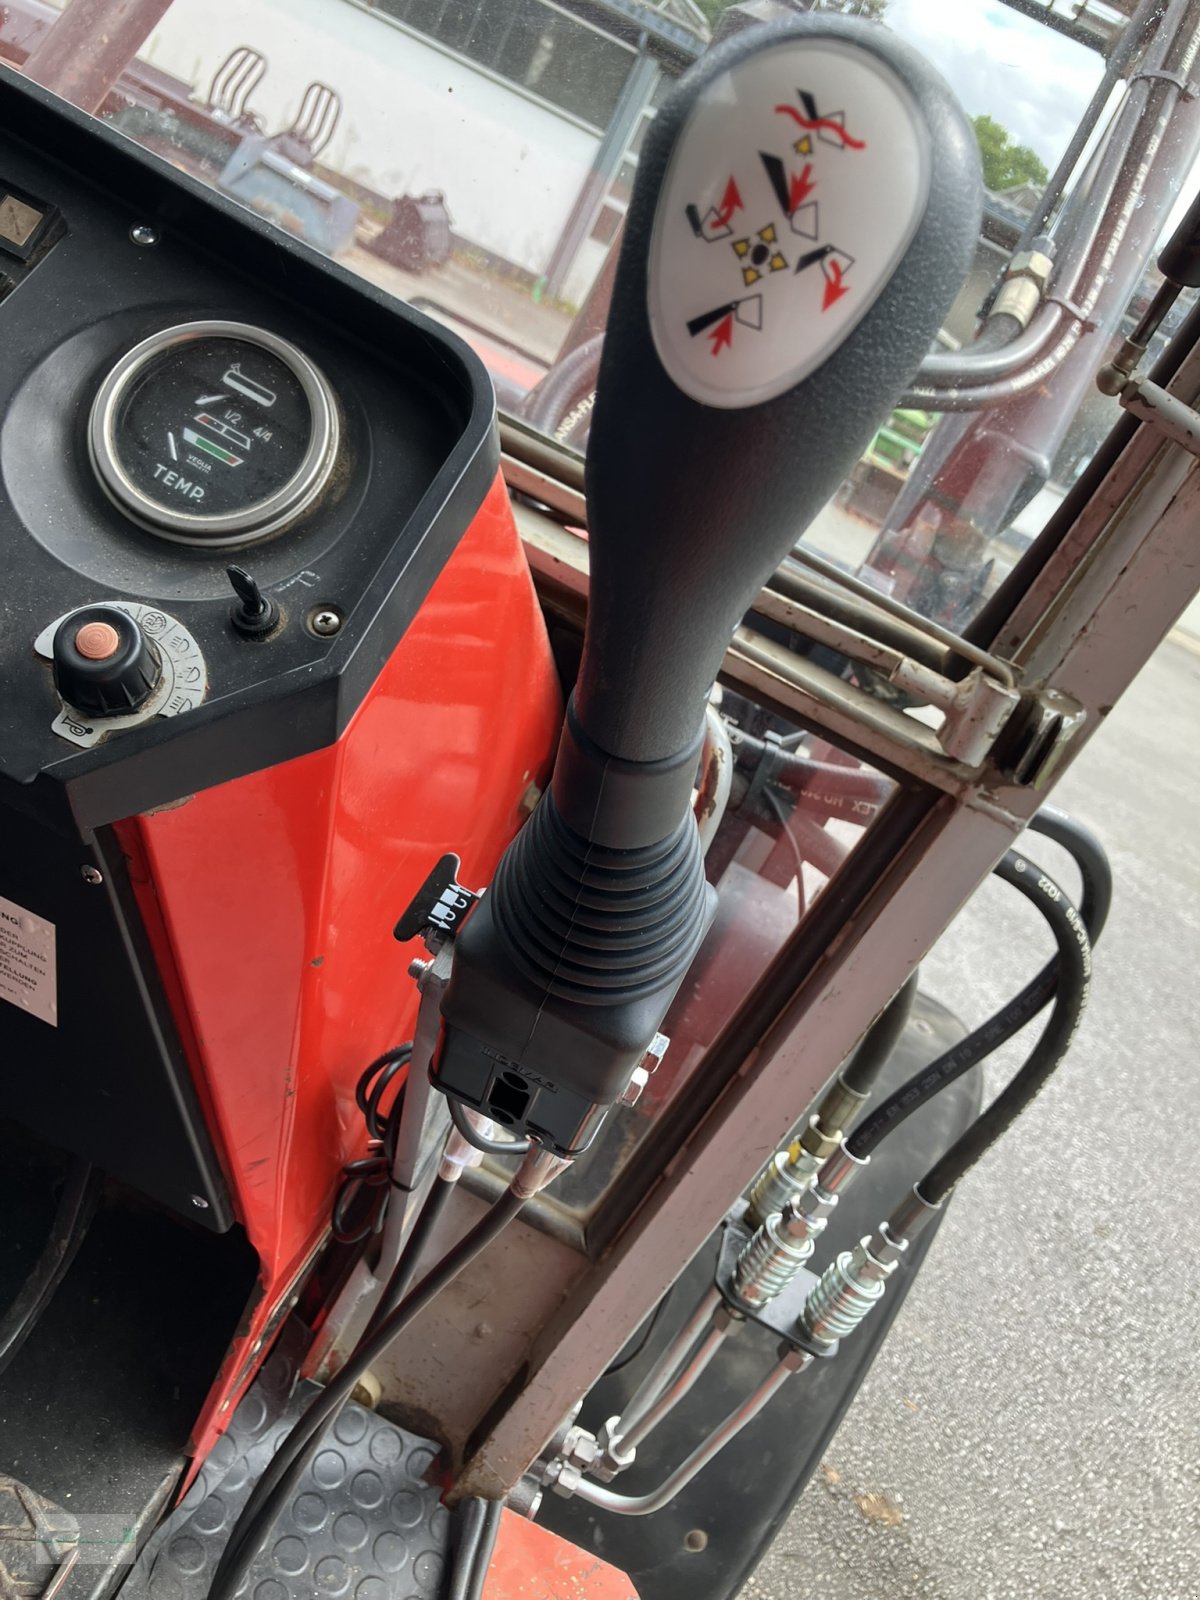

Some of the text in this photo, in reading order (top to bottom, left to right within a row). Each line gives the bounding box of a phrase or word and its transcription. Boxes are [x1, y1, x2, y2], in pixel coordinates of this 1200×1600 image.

[252, 426, 273, 443] 4/4
[188, 454, 213, 471] VEGLIA
[8, 946, 28, 960] ZUM
